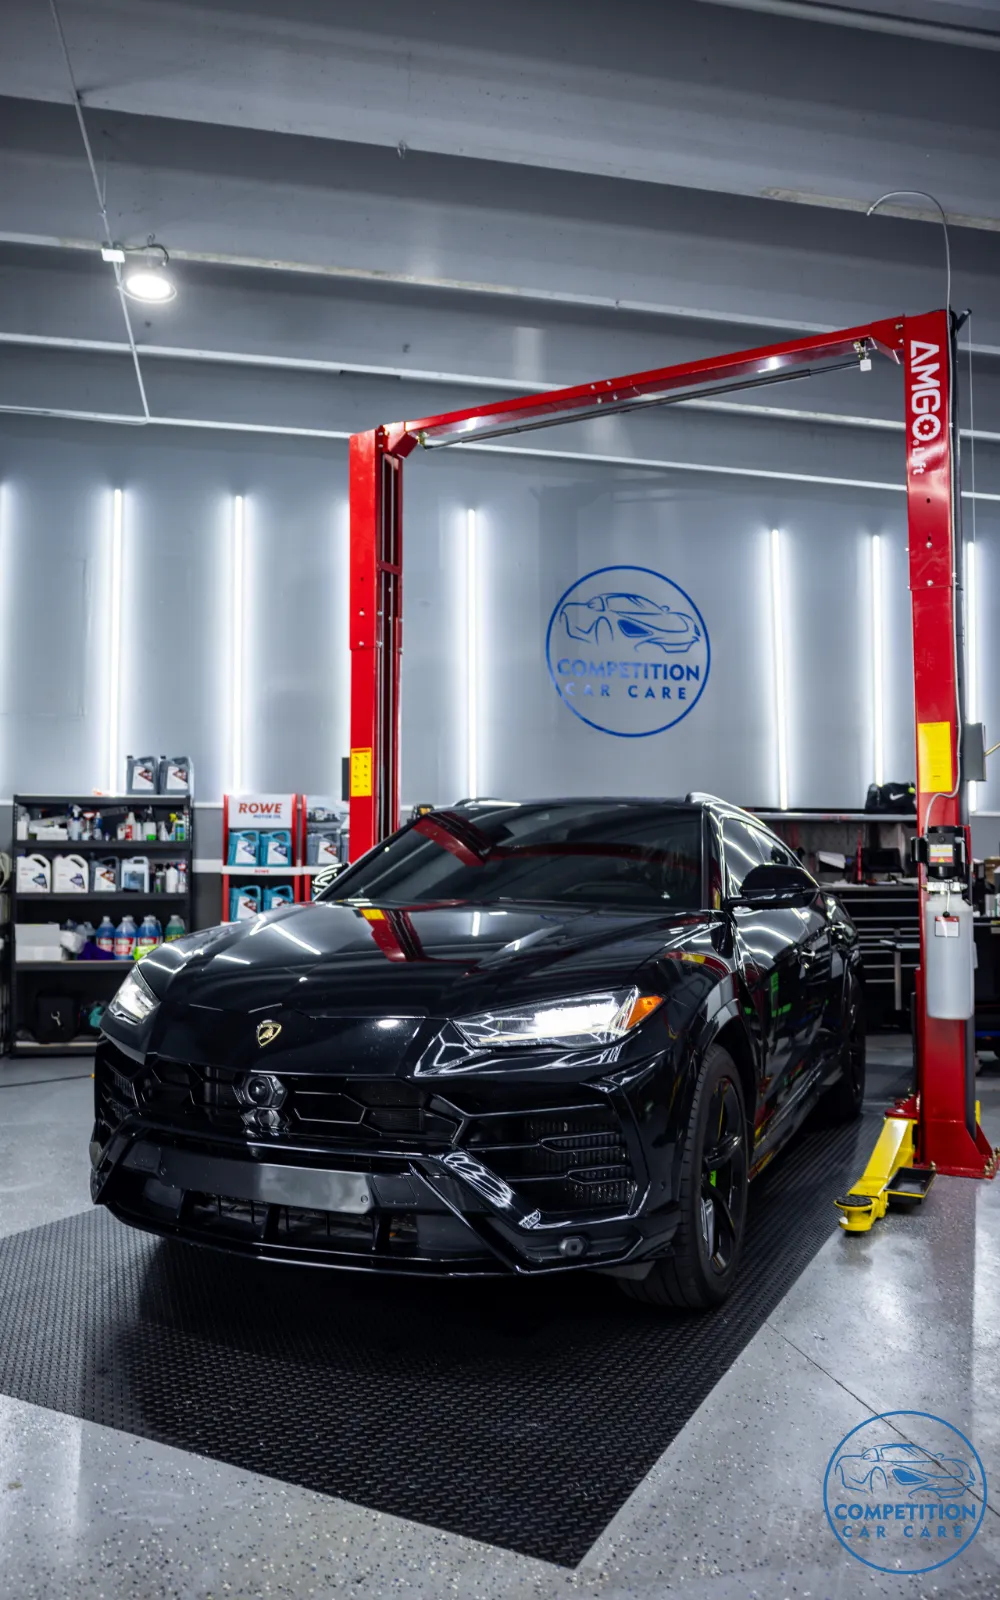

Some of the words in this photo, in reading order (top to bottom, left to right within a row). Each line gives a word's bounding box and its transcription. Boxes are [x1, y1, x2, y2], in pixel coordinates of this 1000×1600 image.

[912, 447, 926, 475] Lft
[557, 658, 700, 682] COMPETITION
[565, 682, 610, 697] CAR
[628, 685, 687, 700] CARE
[238, 803, 282, 814] ROWE
